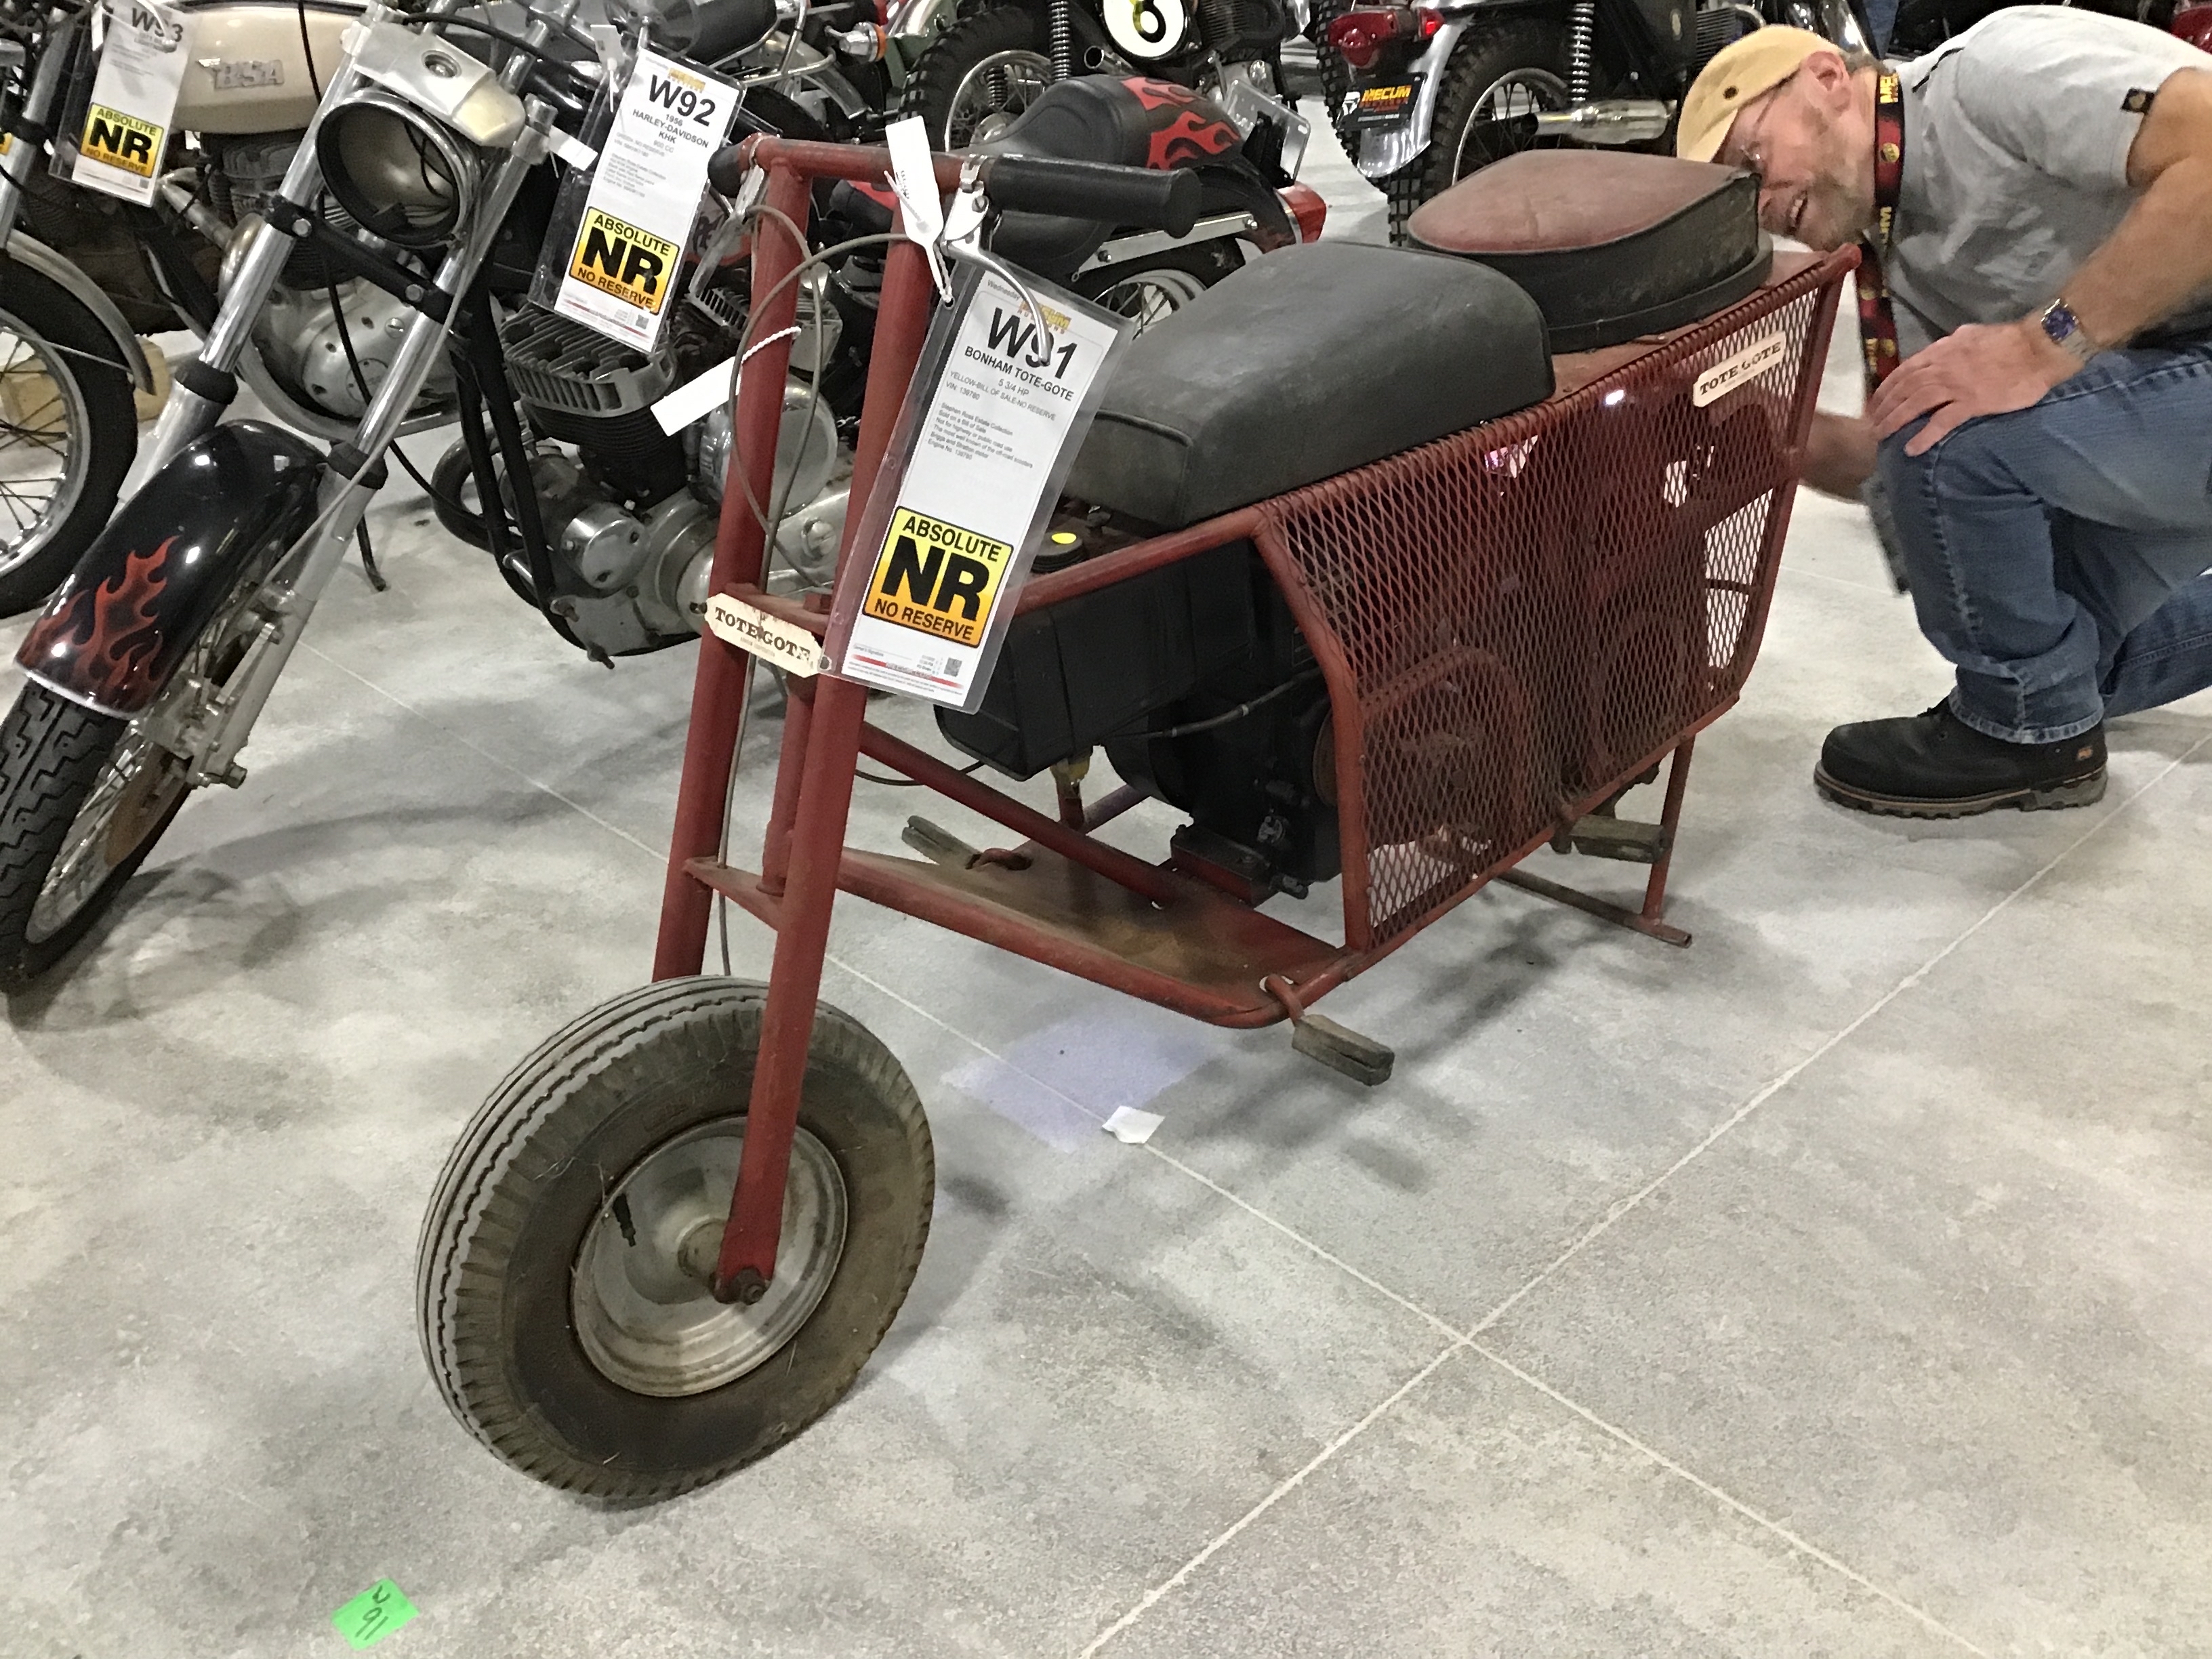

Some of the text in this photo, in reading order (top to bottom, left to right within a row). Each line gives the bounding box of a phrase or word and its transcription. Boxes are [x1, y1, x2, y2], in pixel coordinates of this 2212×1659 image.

[215, 60, 284, 89] BSA
[1361, 85, 1412, 102] MECUM
[649, 75, 715, 126] W92
[666, 114, 683, 126] 1956
[89, 117, 152, 165] NR
[97, 108, 157, 136] ABSOLUTE
[632, 109, 709, 148] HARLEY-DAVIDSON
[659, 131, 677, 144] KHK
[86, 147, 147, 173] NO RESERVE
[594, 214, 671, 256] ABSOLUTE
[581, 226, 663, 295] NR
[577, 268, 654, 308] NO RESERVE
[987, 279, 1021, 301] Wednesday
[987, 307, 1078, 379] W91
[964, 346, 1074, 401] BONHAM TOTE-GOTE
[1700, 365, 1738, 395] TOTE
[1742, 342, 1781, 370] GOTE
[950, 371, 989, 392] YELLOW-BILL
[990, 388, 999, 396] OF
[1027, 402, 1057, 421] RESERVE
[1005, 381, 1017, 392] 3/4
[1017, 386, 1029, 396] HP
[934, 424, 943, 432] The
[939, 410, 949, 419] Sold
[975, 424, 986, 434] Sale
[941, 403, 961, 415] Stephen
[990, 423, 1013, 436] Collection
[928, 438, 944, 450] Engine
[902, 516, 1002, 562] ABSOLUTE
[880, 535, 989, 621] NR
[715, 607, 758, 638] TOTE
[762, 631, 811, 661] GOTE
[874, 598, 975, 640] NO RESERVE
